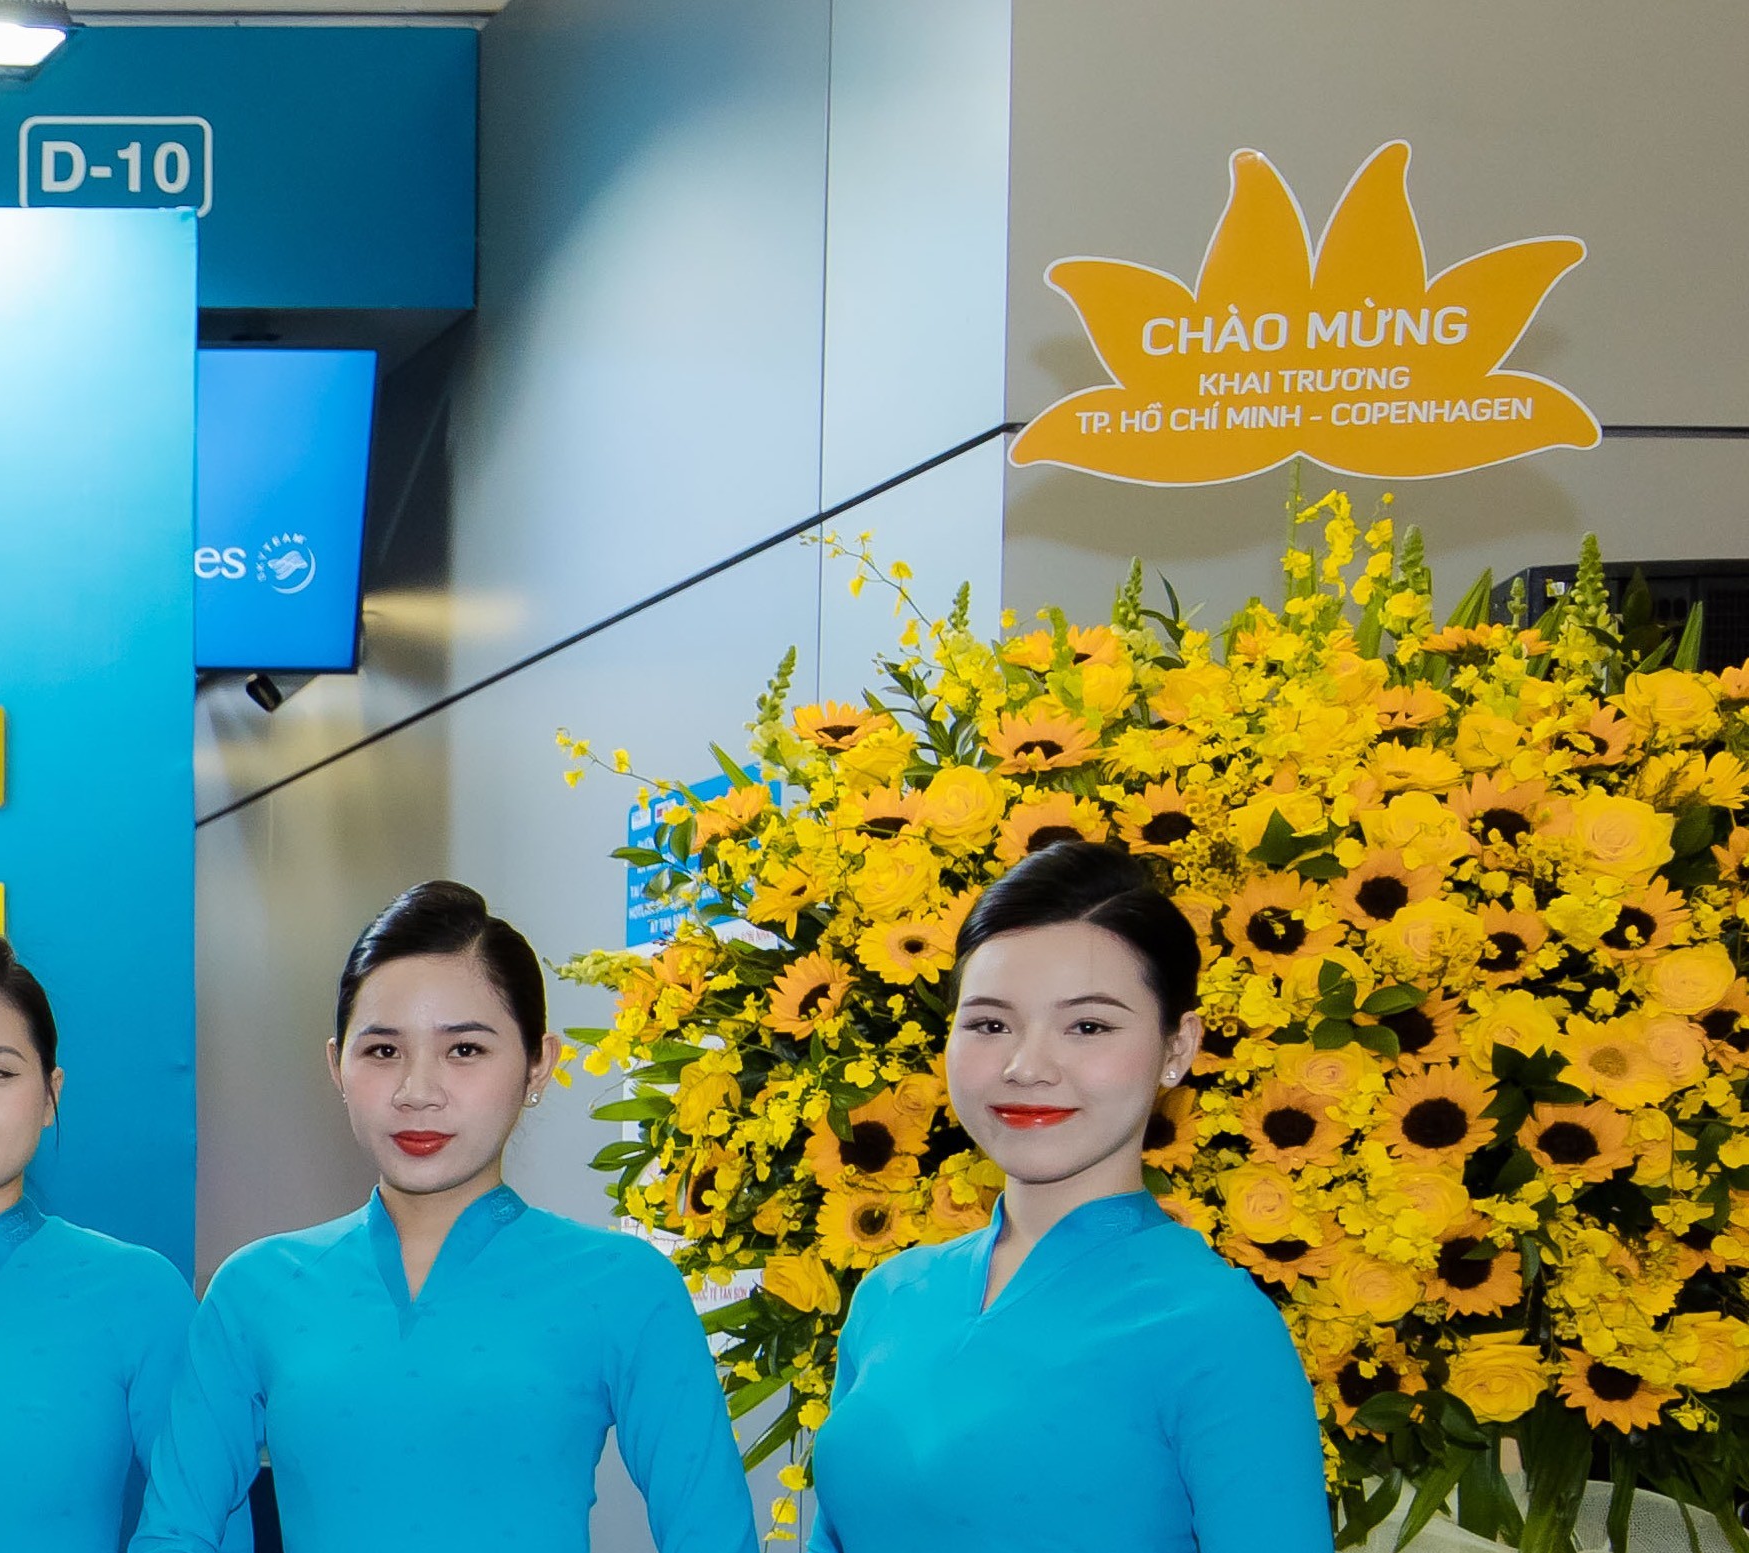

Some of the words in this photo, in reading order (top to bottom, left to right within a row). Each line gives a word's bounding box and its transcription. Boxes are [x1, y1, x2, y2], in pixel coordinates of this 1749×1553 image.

[40, 140, 191, 193] D-10
[1141, 303, 1288, 356] CHÀO
[1306, 297, 1469, 353] MỪNG
[1198, 372, 1271, 397] KHAI
[1278, 366, 1411, 393] TRƯƠNG
[1075, 411, 1112, 435] TP.
[1120, 402, 1166, 433] HỒ
[1169, 401, 1219, 431] CHÍ
[1226, 404, 1301, 430] MINH
[1331, 397, 1533, 428] COPENHAGEN
